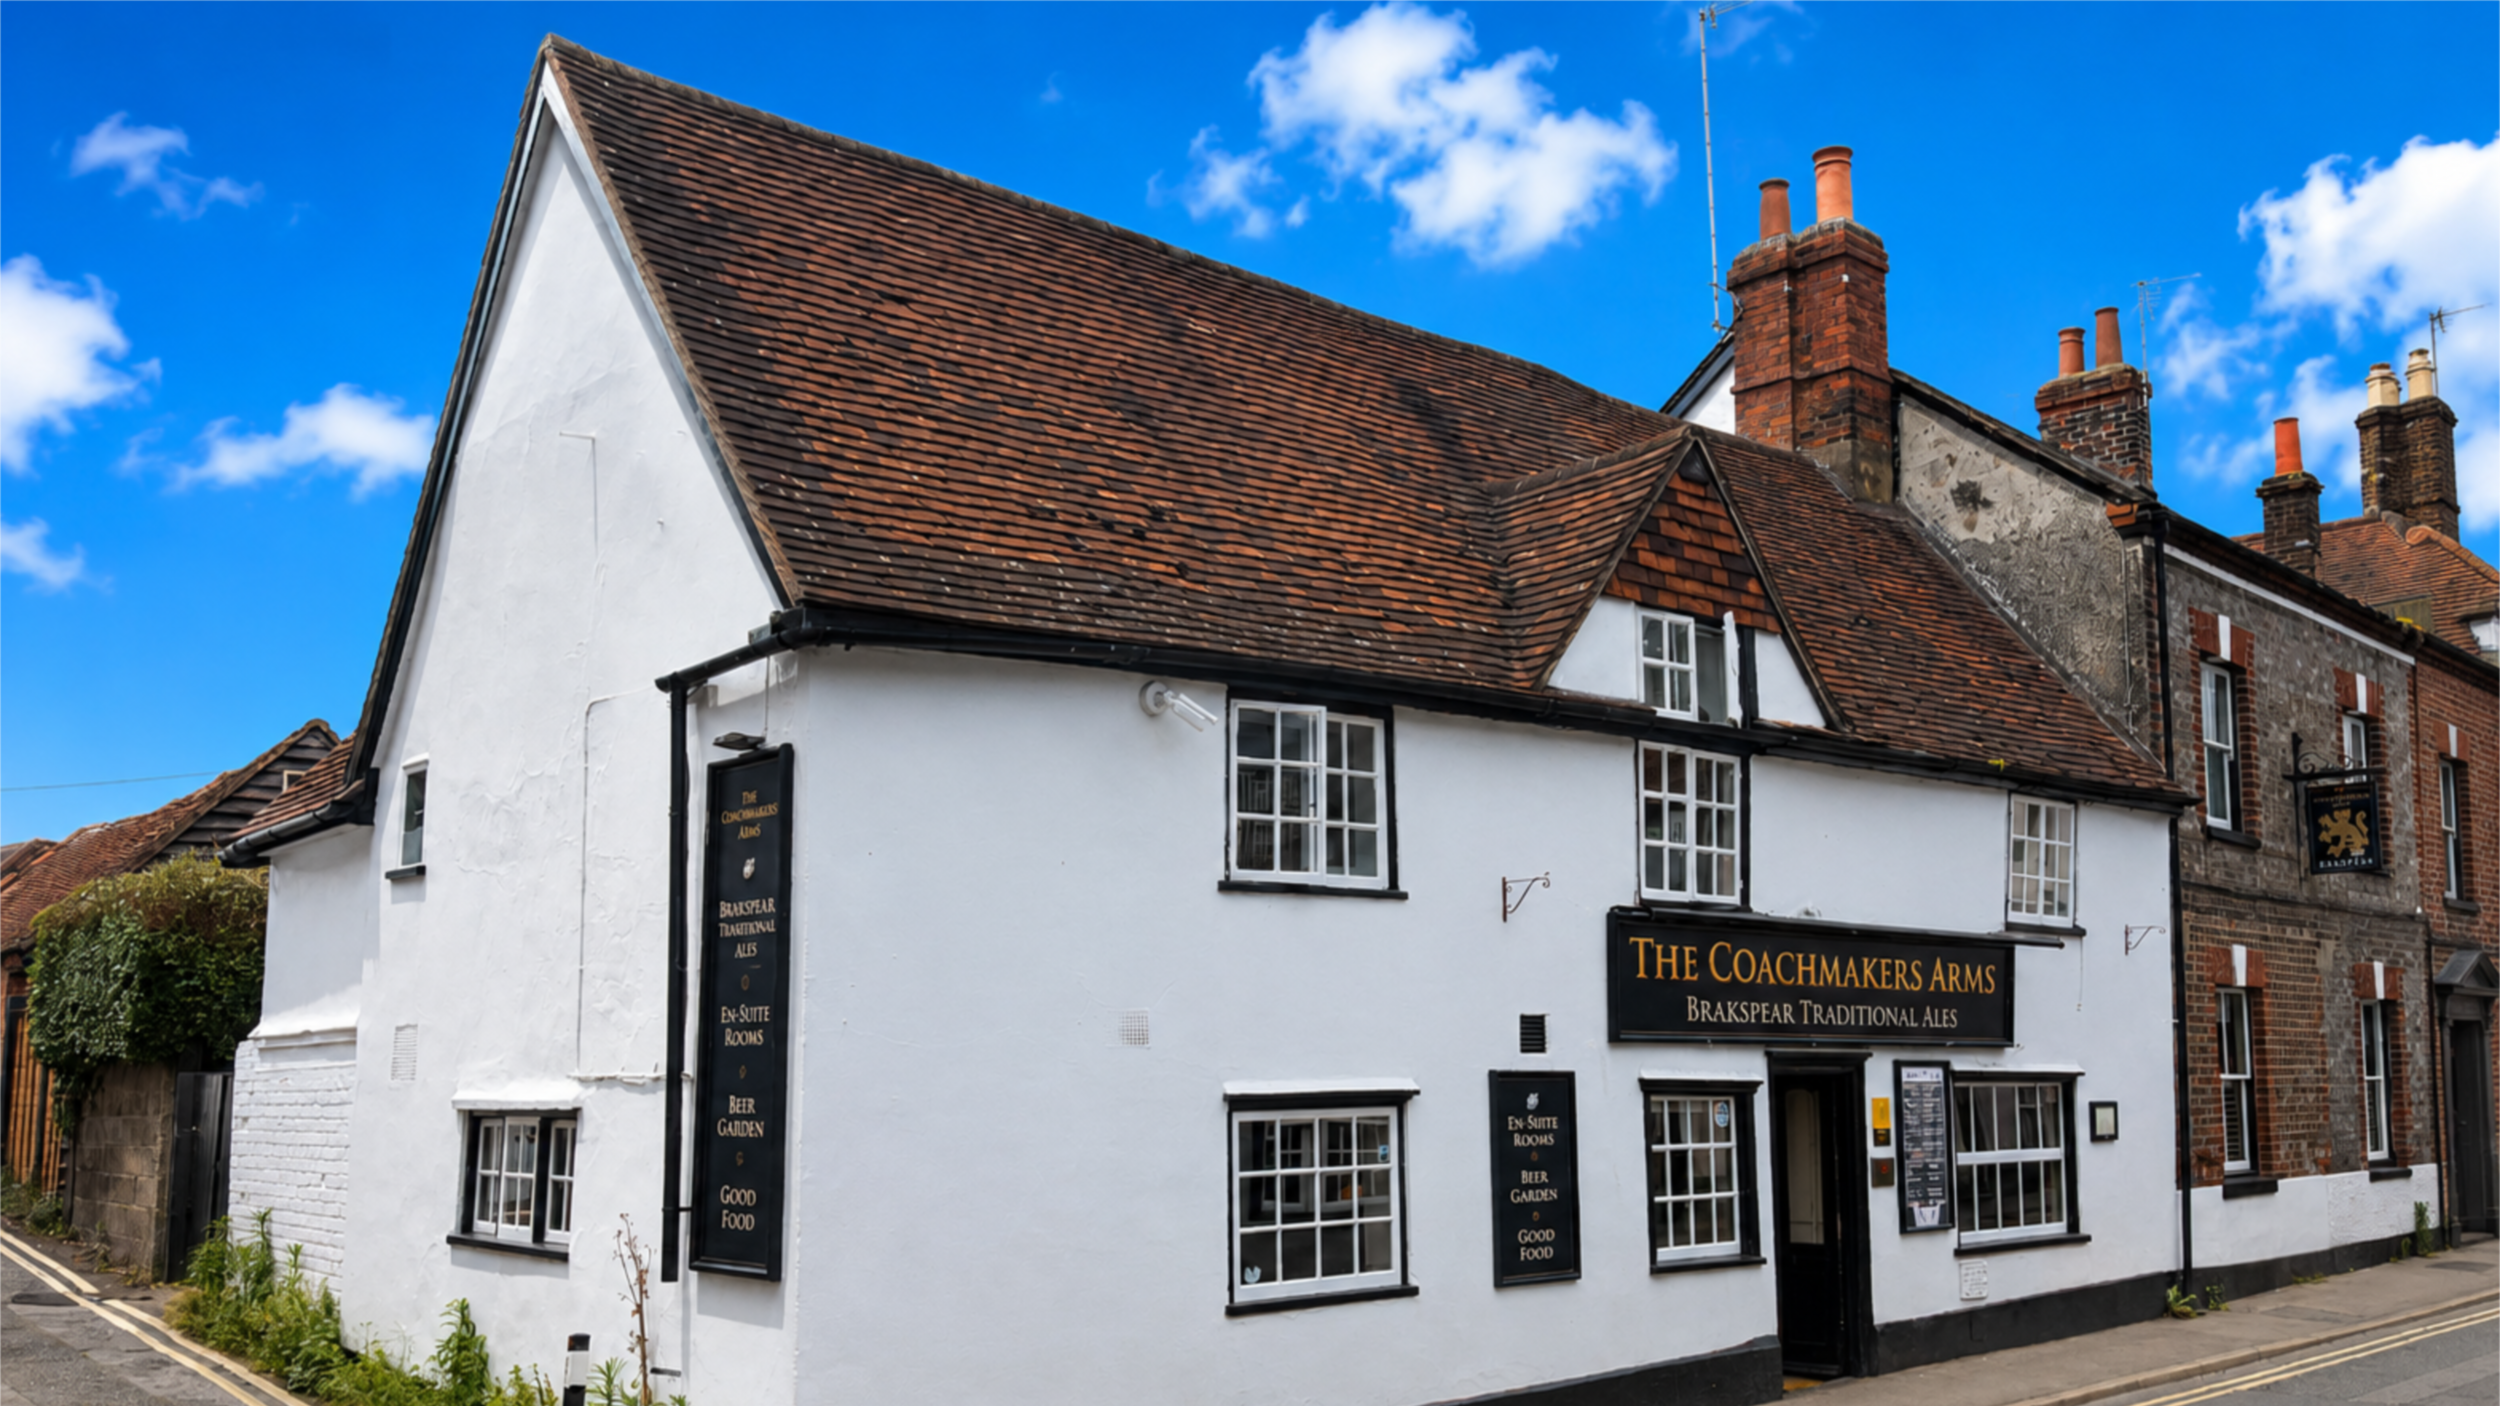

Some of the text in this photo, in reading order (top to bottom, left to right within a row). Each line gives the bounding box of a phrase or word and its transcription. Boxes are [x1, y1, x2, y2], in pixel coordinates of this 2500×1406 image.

[735, 943, 757, 958] ALES
[1629, 937, 1996, 993] THE COACHMAKERS ARMS
[721, 1005, 770, 1023] EN-SUITE
[1687, 996, 1958, 1028] BRAKSPEAR TRADITIONAL ALES
[725, 1028, 763, 1046] ROOMS
[729, 1095, 756, 1114] BEER
[717, 1119, 764, 1138] GARDEN
[1508, 1115, 1558, 1131] EN-SUITE
[1521, 1170, 1549, 1184] BEER
[720, 1185, 756, 1206] GOOD
[1510, 1188, 1558, 1203] GARDEN
[721, 1210, 754, 1231] FOOD
[1518, 1229, 1555, 1244] GOOD
[1520, 1247, 1553, 1261] FOOD
